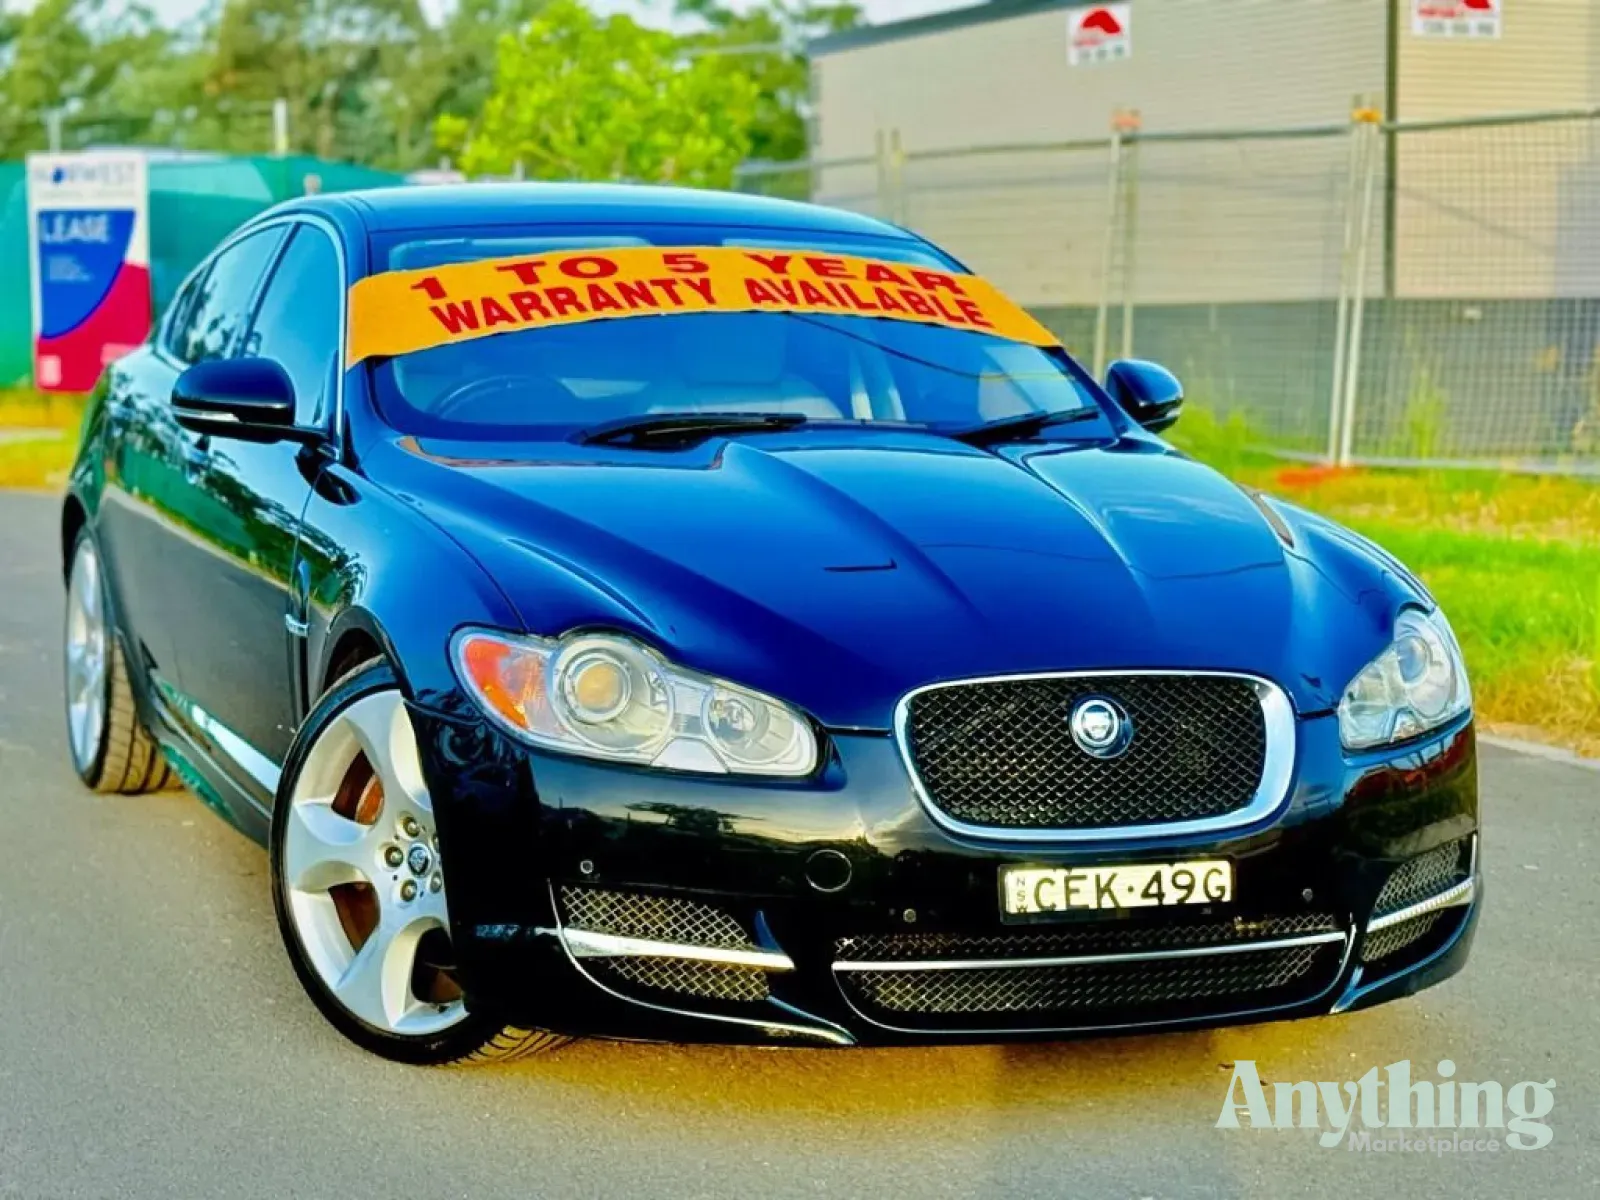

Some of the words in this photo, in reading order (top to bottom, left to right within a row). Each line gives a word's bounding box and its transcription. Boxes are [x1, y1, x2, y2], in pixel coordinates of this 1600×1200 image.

[39, 213, 109, 243] LEASE
[410, 277, 448, 300] 1
[495, 256, 618, 286] TO
[662, 253, 711, 274] 5
[743, 253, 968, 297] YEAR
[429, 277, 718, 334] WARRANTY
[743, 277, 995, 329] AVAILABLE
